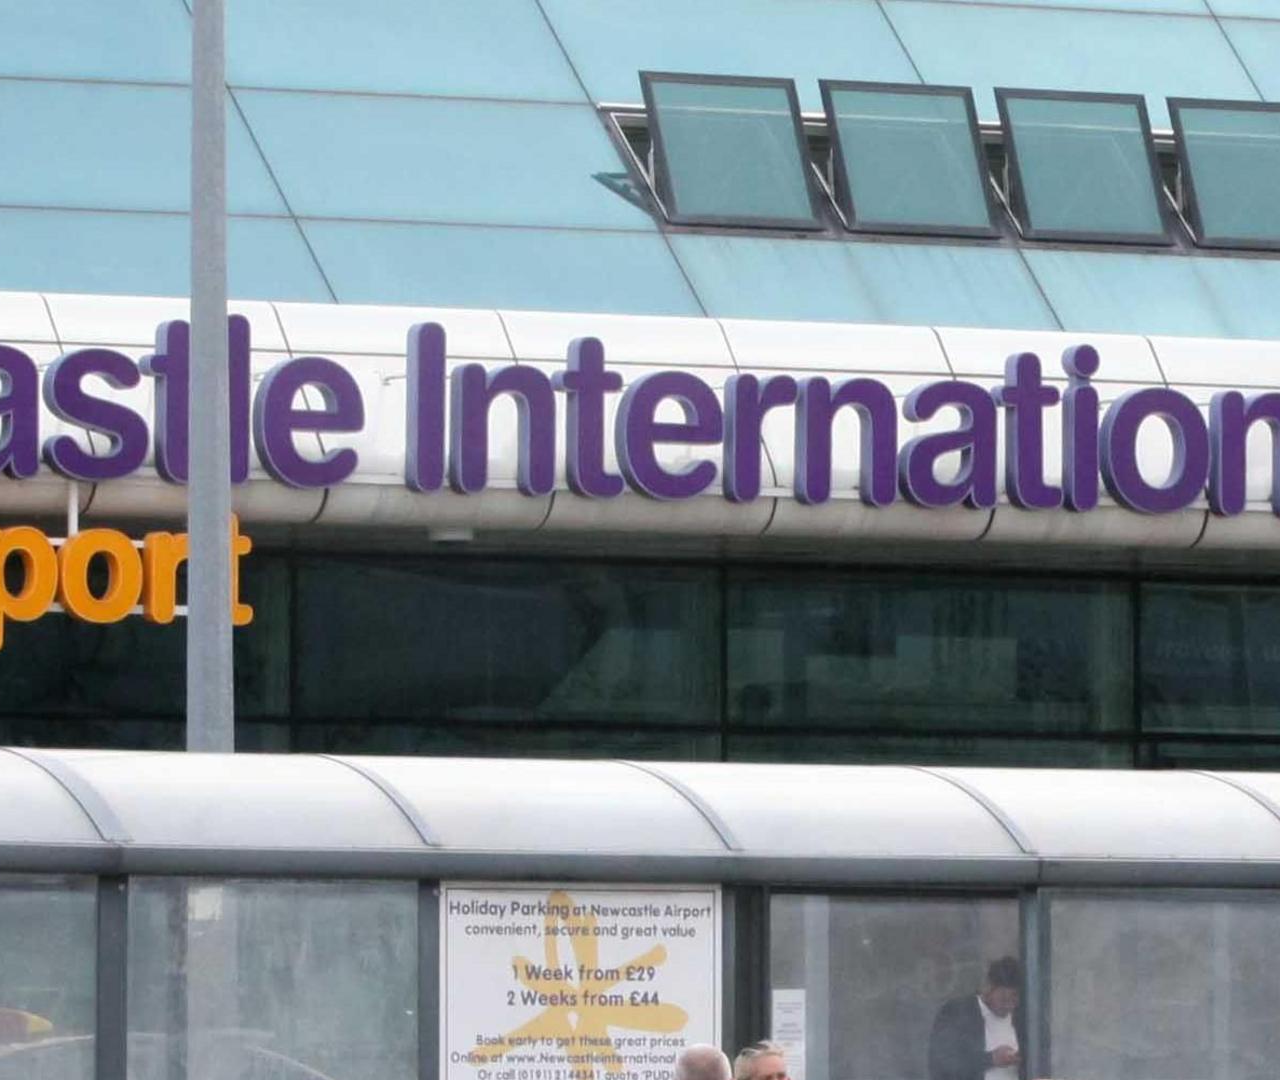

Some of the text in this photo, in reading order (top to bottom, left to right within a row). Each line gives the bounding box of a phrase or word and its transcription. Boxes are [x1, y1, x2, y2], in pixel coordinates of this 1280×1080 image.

[449, 900, 711, 920] Holiday Parking at Newcastle Airport
[464, 922, 697, 940] convenient, secure and great value
[512, 964, 656, 982] 1 Week from £29
[506, 990, 660, 1007] 2 Weeks from £44
[476, 1033, 505, 1045] Book
[508, 1034, 538, 1048] early
[540, 1035, 553, 1046] to
[579, 1034, 612, 1047] these
[614, 1036, 647, 1049] great
[650, 1034, 686, 1049] prices
[450, 1051, 488, 1064] Online
[478, 1069, 492, 1080] Or
[496, 1069, 516, 1080] call
